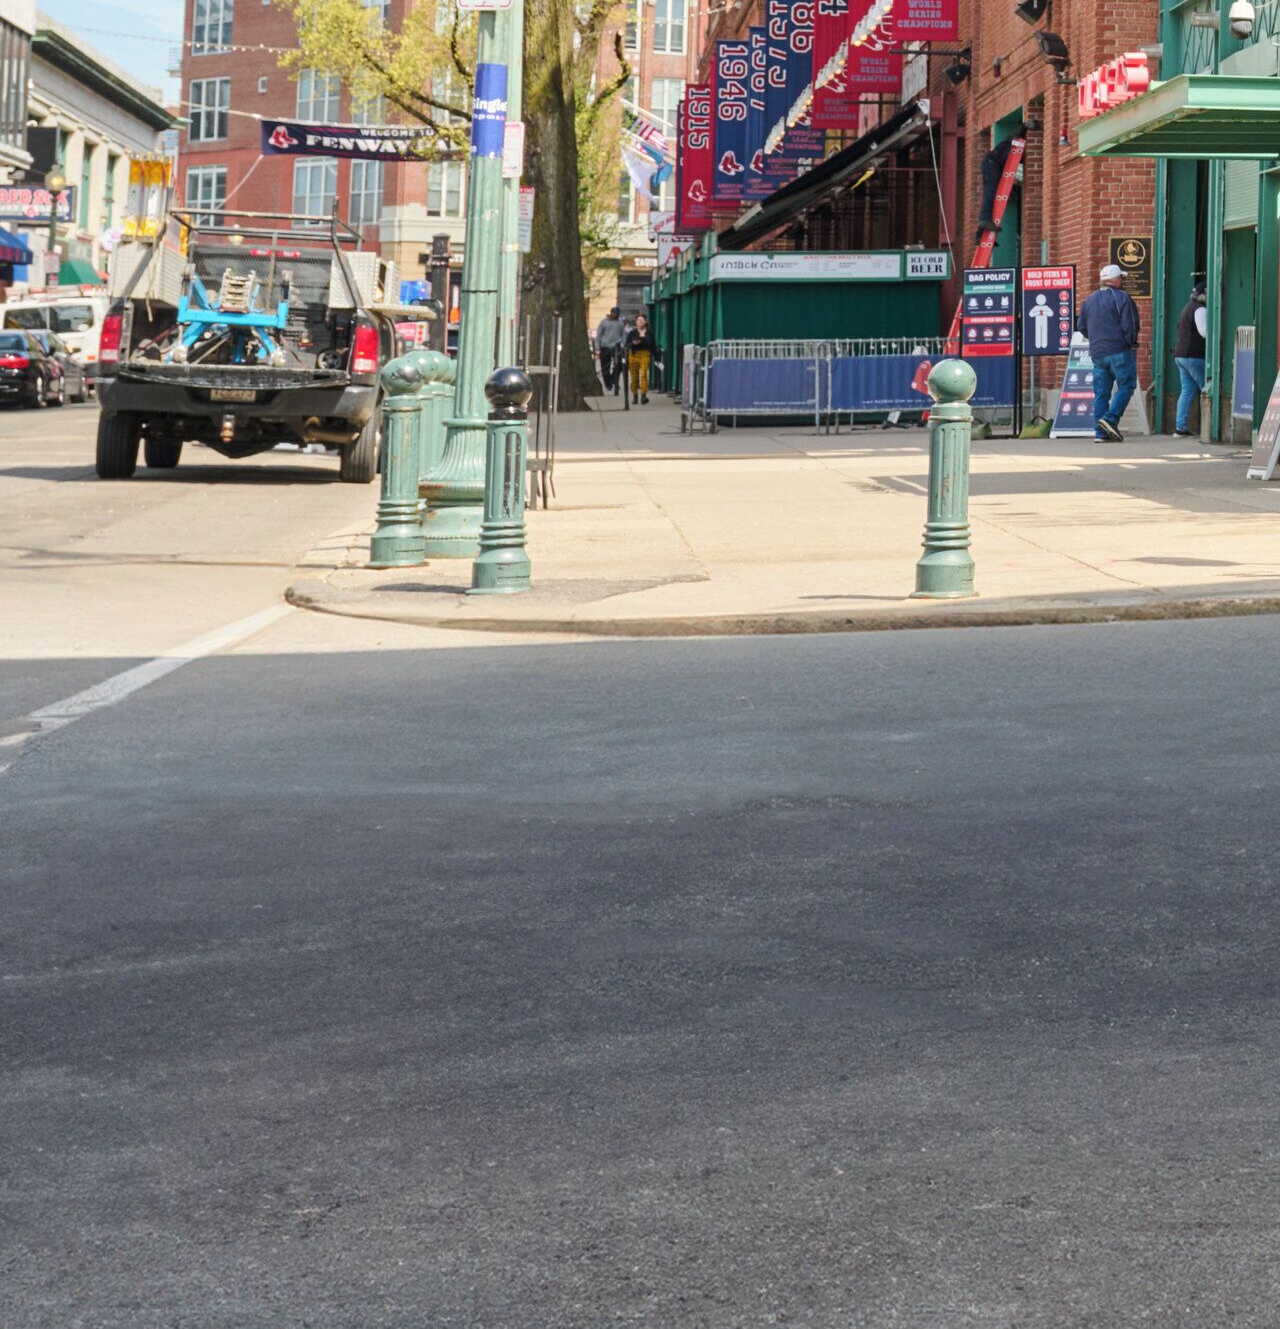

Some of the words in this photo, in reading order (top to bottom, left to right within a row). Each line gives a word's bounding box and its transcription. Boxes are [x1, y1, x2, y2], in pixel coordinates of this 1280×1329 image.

[908, 0, 942, 8] WORLD
[908, 10, 942, 18] SERIES
[897, 20, 953, 28] CHAMPIONS
[718, 44, 748, 121] 1946
[688, 87, 710, 149] 1915
[360, 128, 415, 137] WELCOME
[306, 134, 411, 153] FENWAY
[911, 264, 943, 273] BEER
[969, 274, 983, 282] BAG
[985, 273, 1010, 281] POLICY
[1025, 279, 1043, 287] FRONT
[1052, 279, 1070, 287] CHEST
